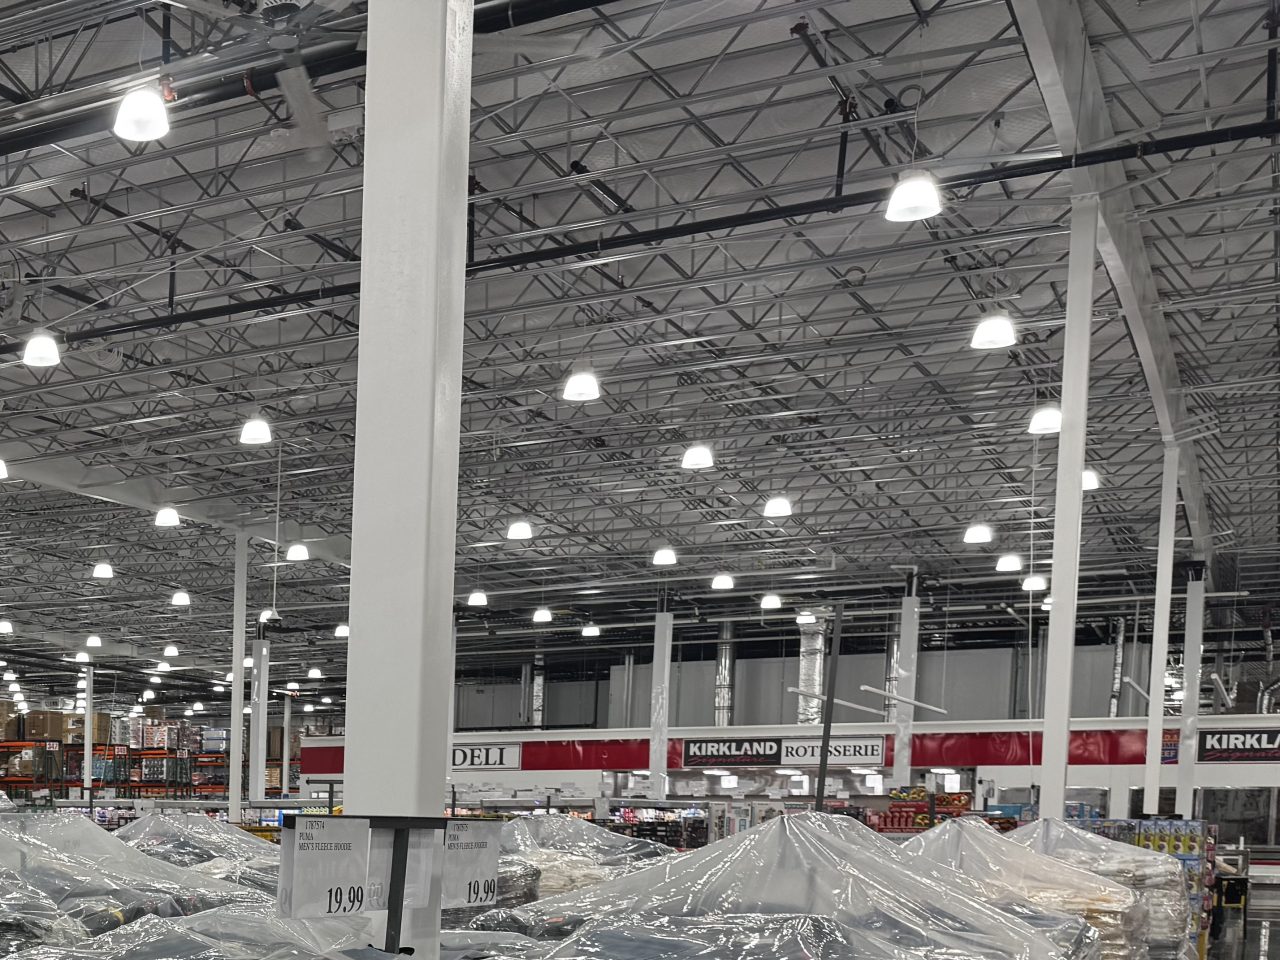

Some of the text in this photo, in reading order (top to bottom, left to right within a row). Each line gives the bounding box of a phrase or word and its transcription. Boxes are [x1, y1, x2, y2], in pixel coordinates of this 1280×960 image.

[452, 747, 506, 767] DELI
[689, 741, 881, 758] KIRKLAND ROTSSERIE
[299, 832, 314, 841] PUMA
[315, 842, 333, 851] FLEECE
[326, 885, 364, 914] 19.99
[467, 878, 496, 904] 19.99
